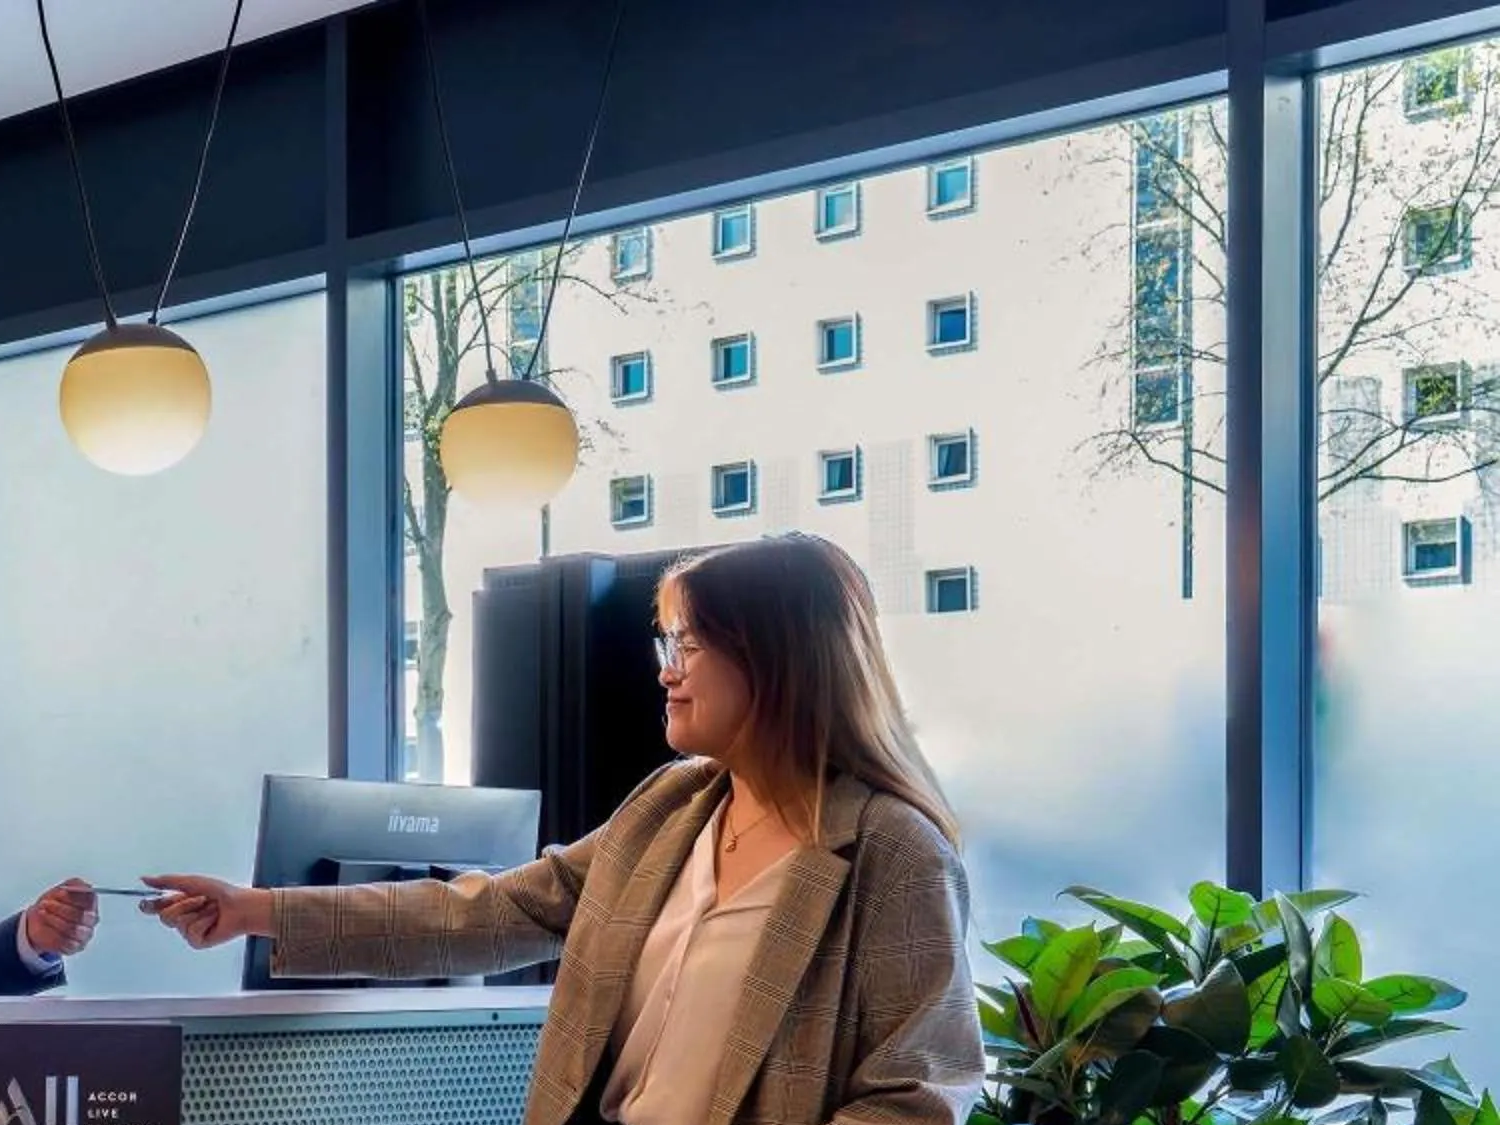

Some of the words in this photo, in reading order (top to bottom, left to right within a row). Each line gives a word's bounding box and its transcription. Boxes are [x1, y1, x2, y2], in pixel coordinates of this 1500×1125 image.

[388, 809, 439, 833] iiyama
[87, 1091, 137, 1102] ACCOR
[87, 1108, 119, 1118] LIVE
